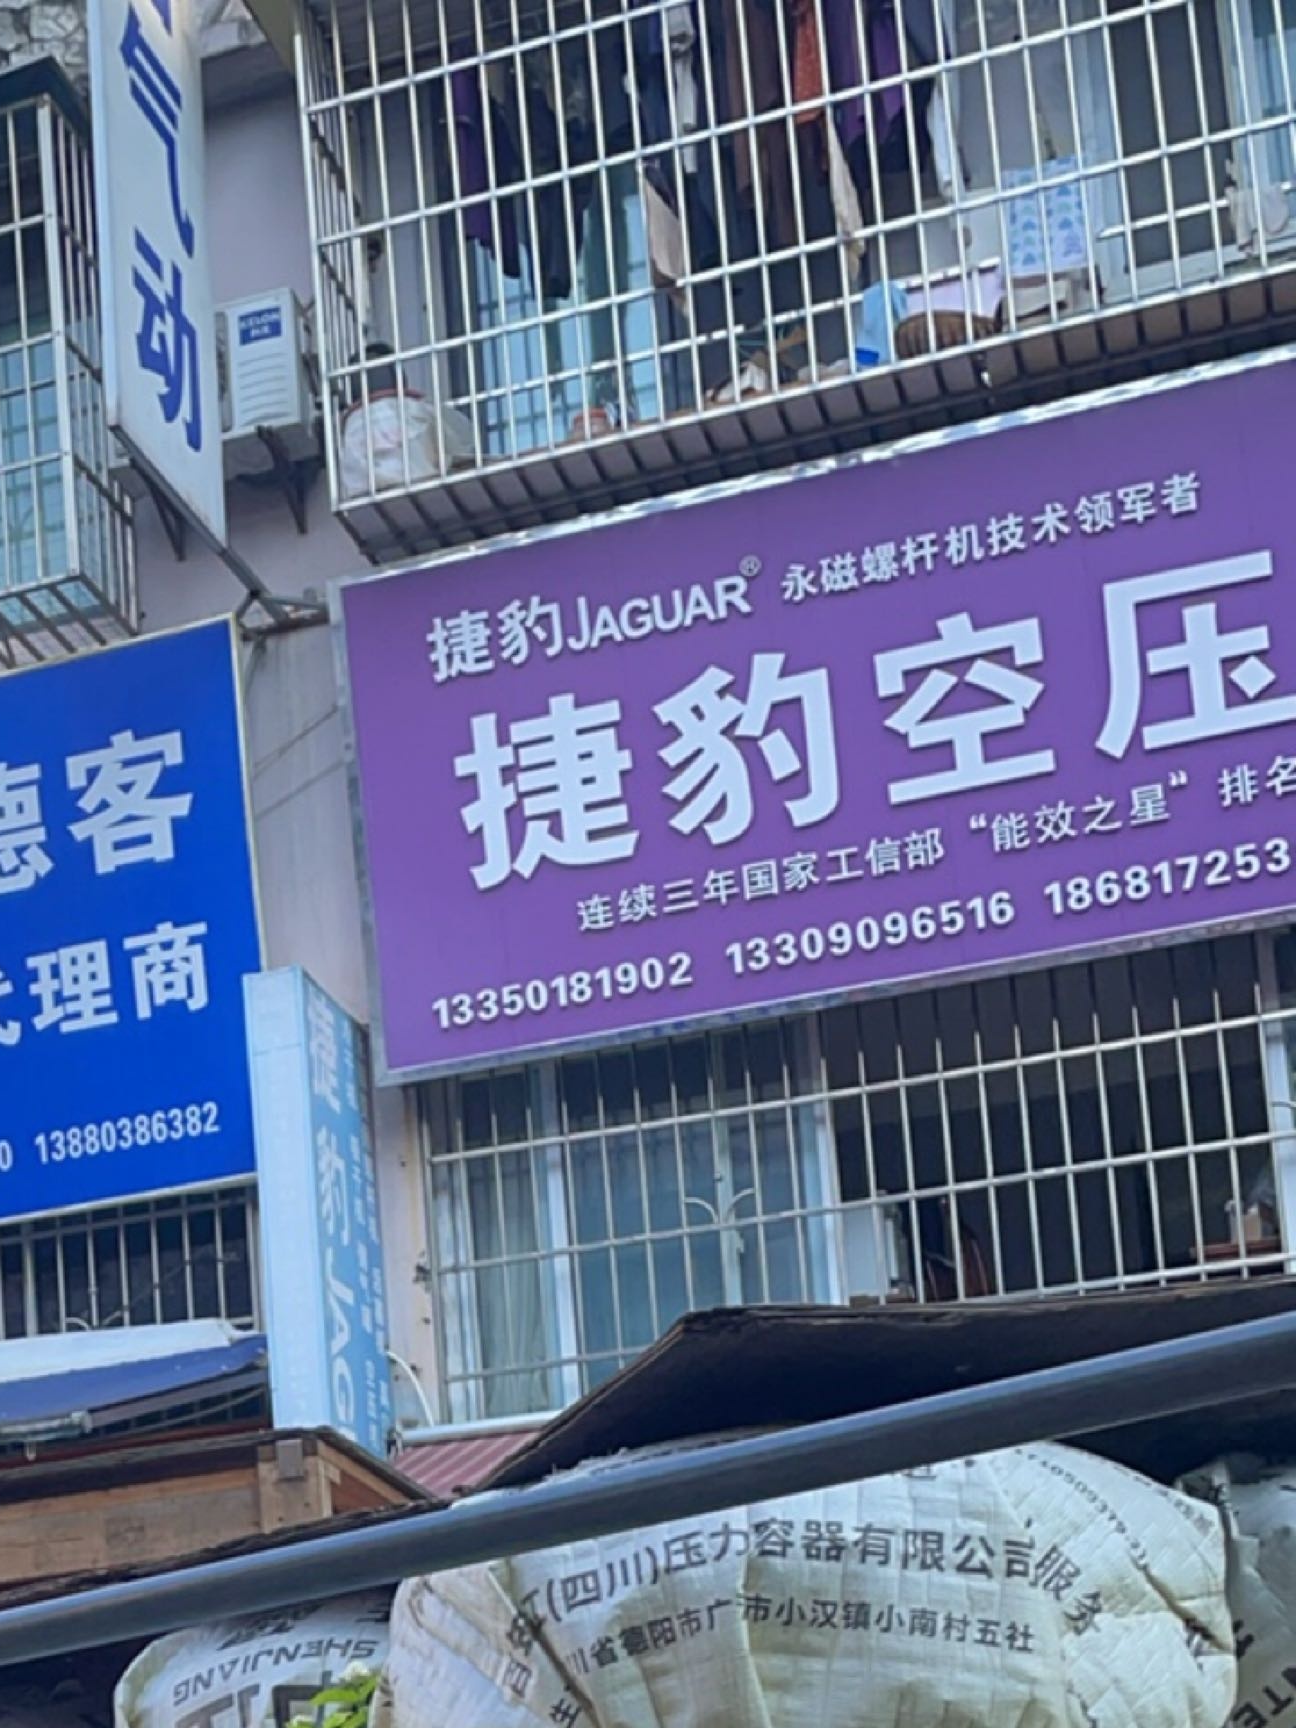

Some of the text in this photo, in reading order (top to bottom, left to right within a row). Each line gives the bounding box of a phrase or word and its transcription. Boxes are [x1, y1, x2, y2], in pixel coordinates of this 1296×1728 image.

[119, 0, 202, 453] 气动
[781, 471, 1201, 602] 永磁螺杆机技术领军者
[453, 549, 1296, 890] 捷豹空压
[433, 836, 1291, 1029] 13350181902 13309096516 186817253
[35, 1101, 219, 1164] 13880386382
[174, 1638, 379, 1706] SHENJIANG
